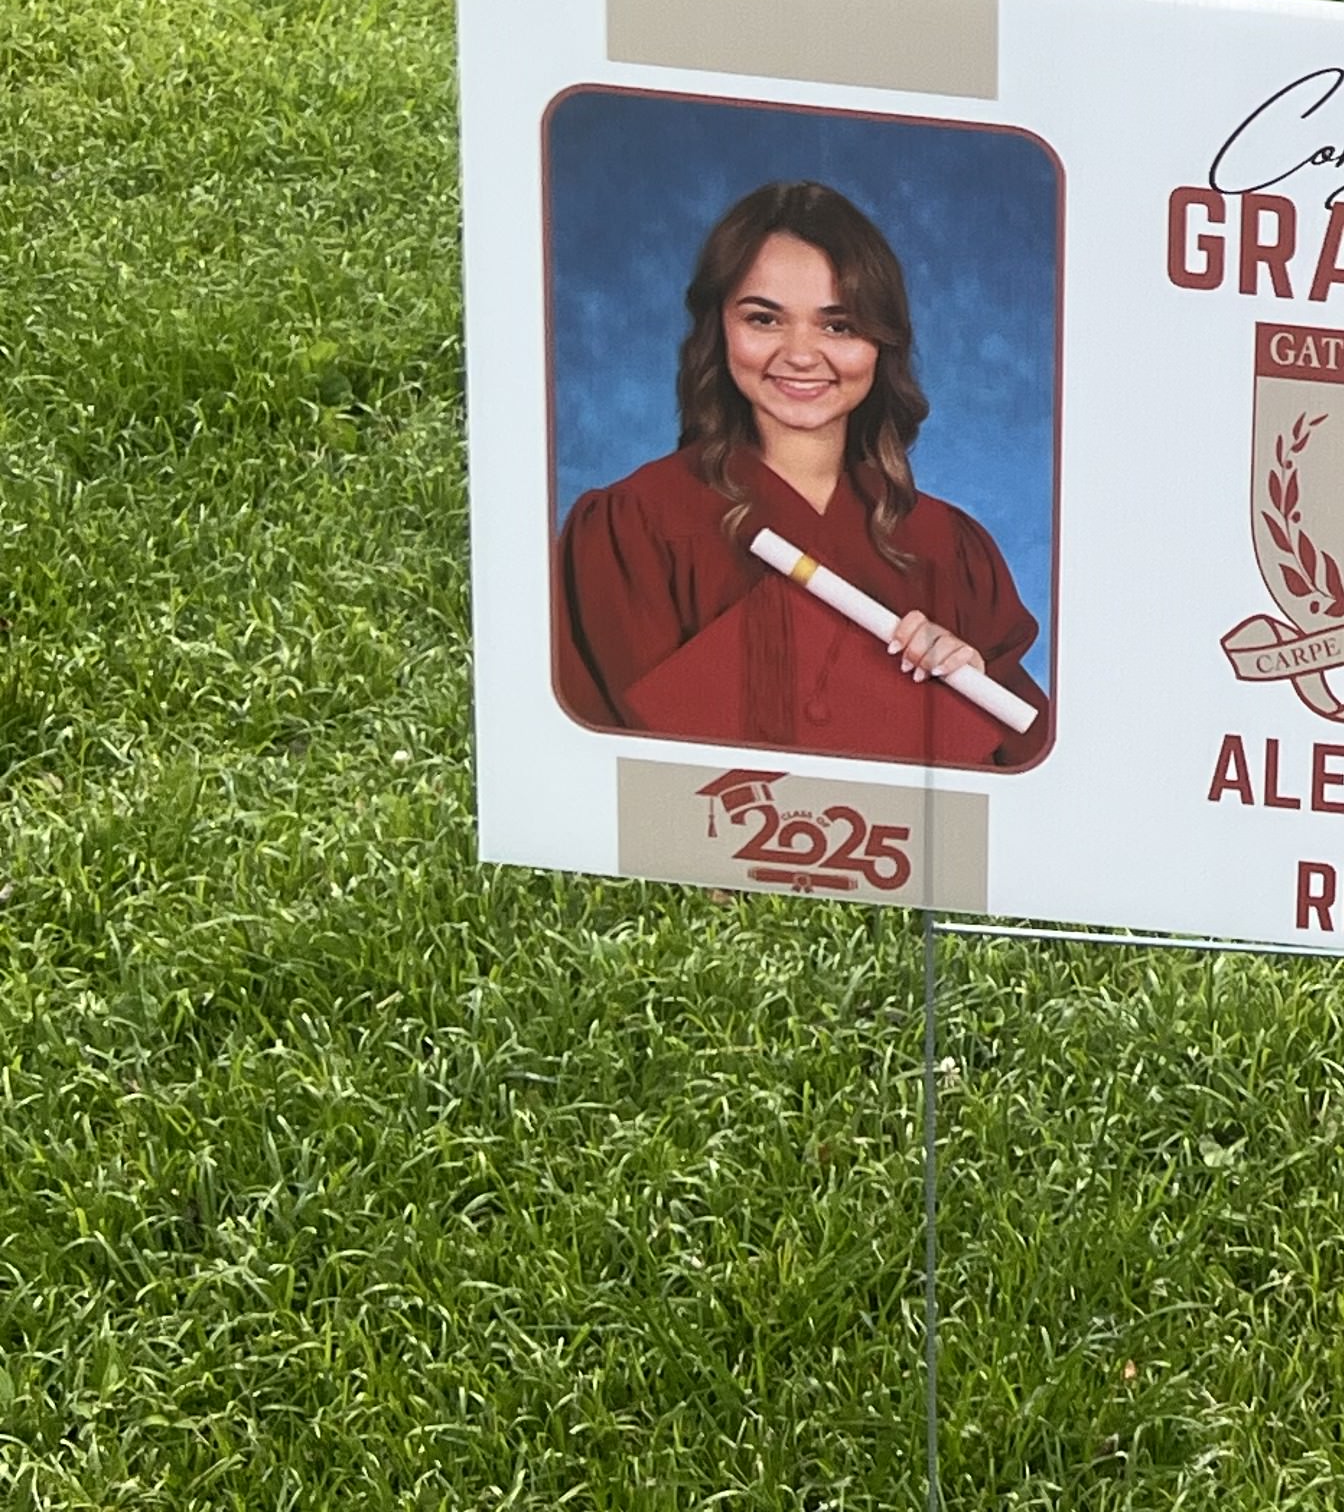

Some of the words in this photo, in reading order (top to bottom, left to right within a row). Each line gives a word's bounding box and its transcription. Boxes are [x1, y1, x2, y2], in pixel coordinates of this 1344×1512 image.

[1254, 632, 1343, 675] CARPE
[780, 809, 814, 821] CLASS
[731, 803, 912, 891] 2025
